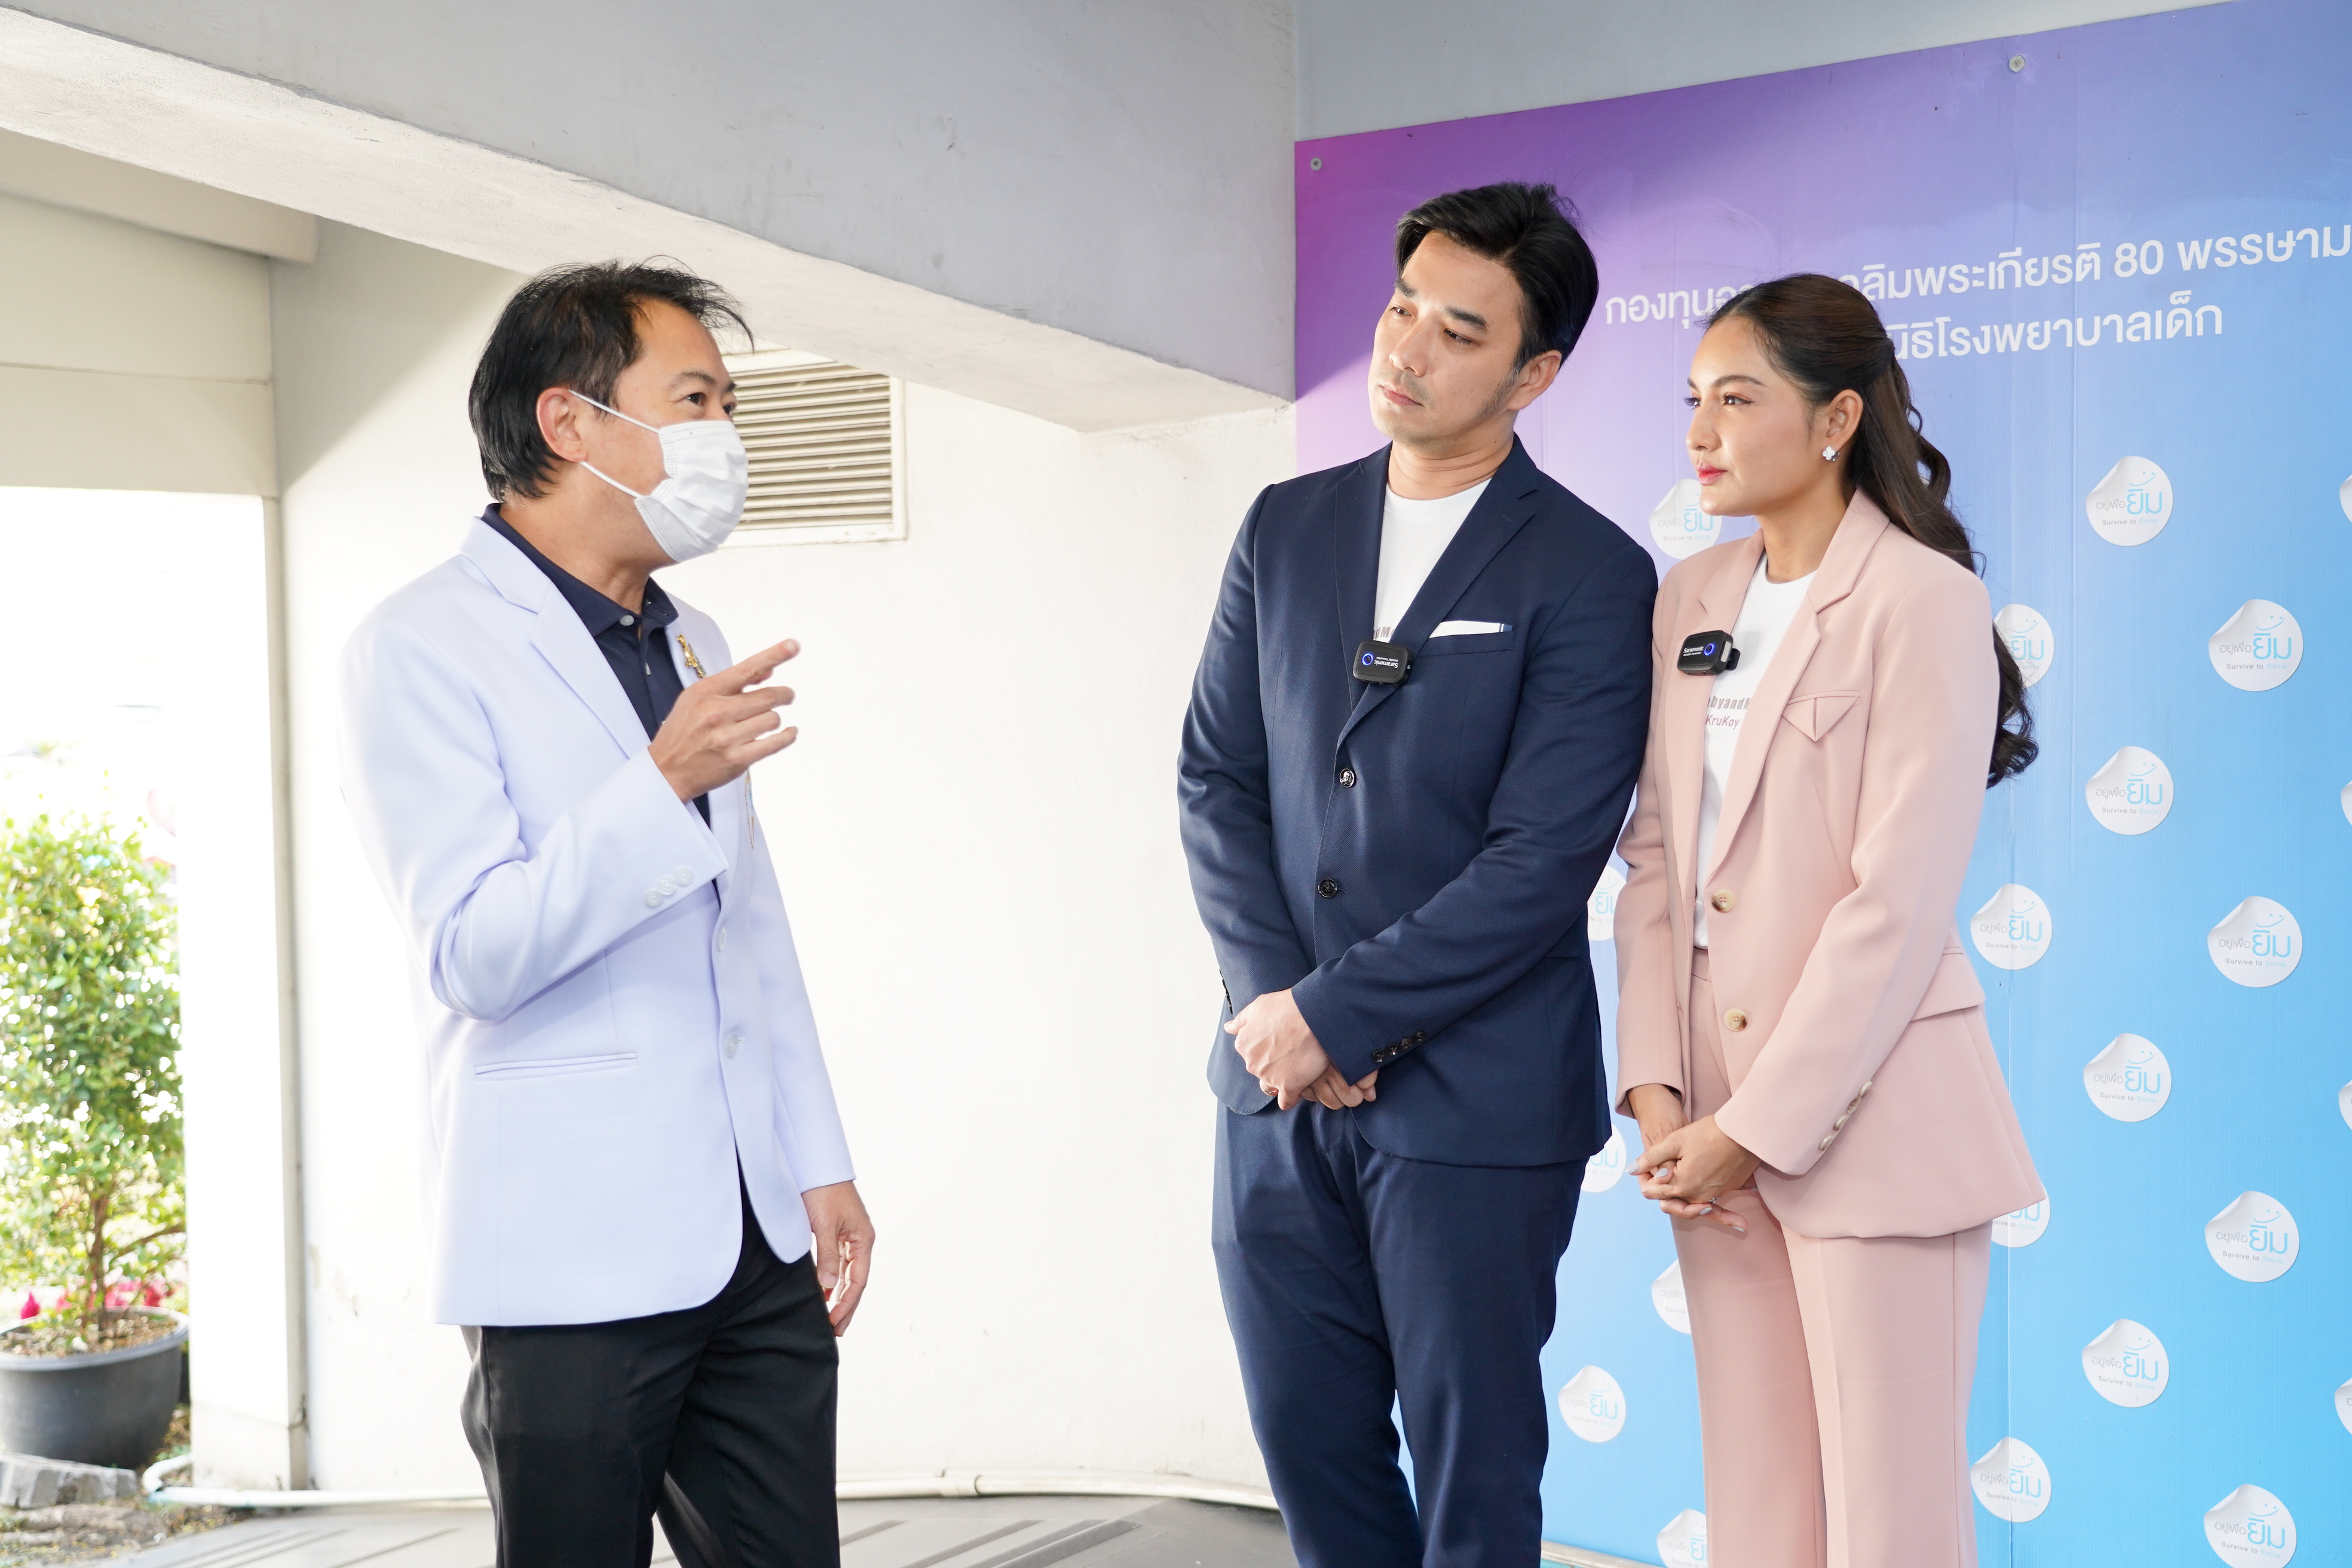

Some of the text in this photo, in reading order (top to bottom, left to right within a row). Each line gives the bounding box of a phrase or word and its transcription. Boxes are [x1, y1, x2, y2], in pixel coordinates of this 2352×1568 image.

[2114, 240, 2164, 278] 80
[2176, 224, 2351, 271] พรรษาม
[1705, 715, 1740, 730] KruKoy
[2221, 1542, 2247, 1551] Survive
